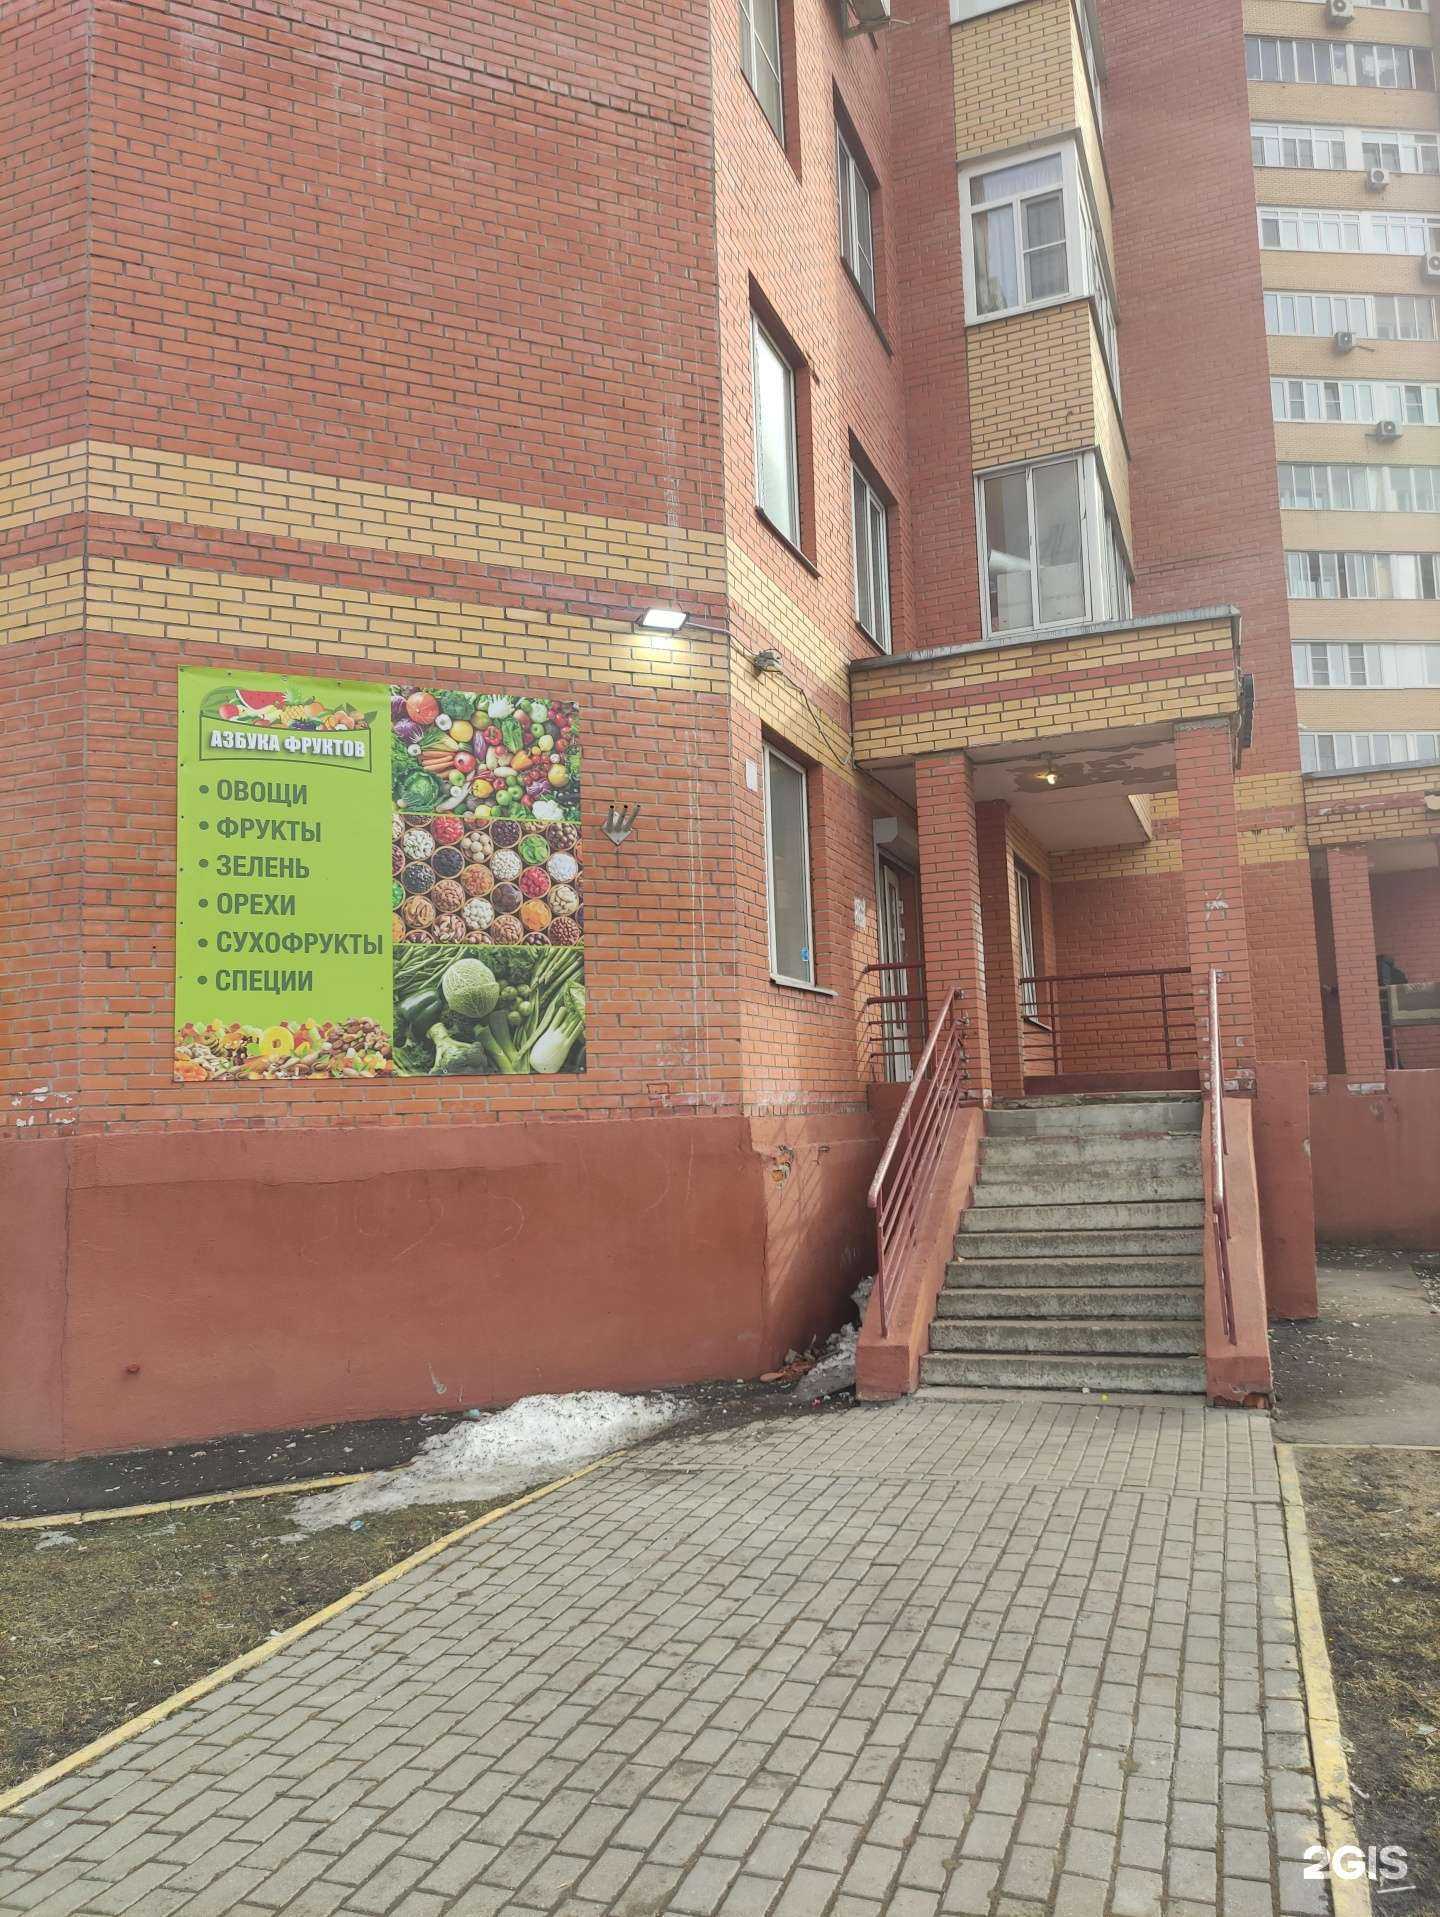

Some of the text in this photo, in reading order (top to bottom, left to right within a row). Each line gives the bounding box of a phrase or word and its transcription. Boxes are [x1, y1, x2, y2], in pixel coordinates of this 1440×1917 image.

[210, 730, 366, 758] АЗБУКА ФРУКТОВ
[216, 779, 308, 807] ОВОЩИ
[216, 816, 321, 842] ФРУКТЫ
[216, 854, 310, 879] ЗЕЛЕНЬ
[216, 892, 296, 916] ОРЕХИ
[216, 931, 383, 955] СУХОФРУКТЫ
[215, 969, 313, 995] СПЕЦИИ
